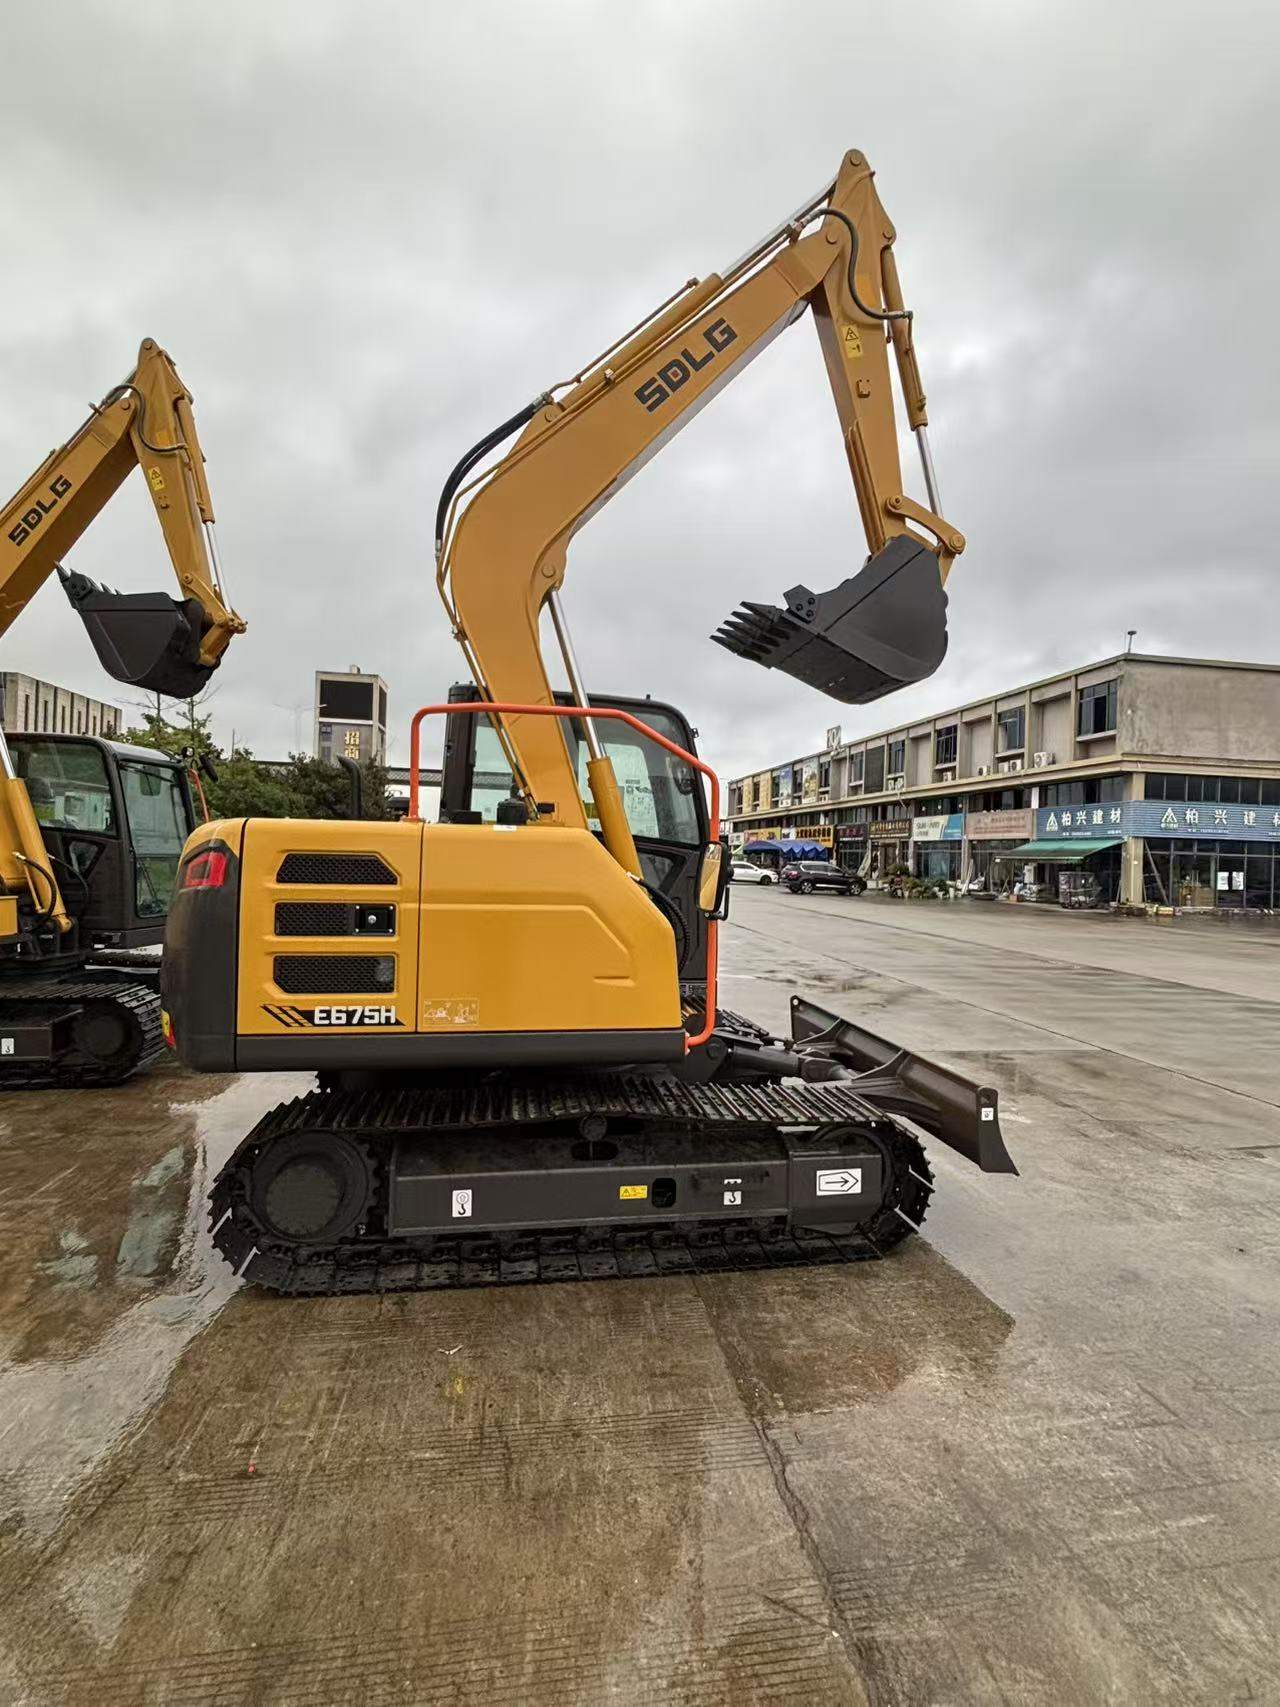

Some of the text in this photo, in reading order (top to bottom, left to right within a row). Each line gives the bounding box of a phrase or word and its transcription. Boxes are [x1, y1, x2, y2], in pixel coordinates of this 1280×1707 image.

[634, 317, 738, 413] SDLG
[8, 474, 72, 547] SDLG
[1061, 807, 1122, 827] 柏兴建材
[314, 1005, 397, 1025] E675H
